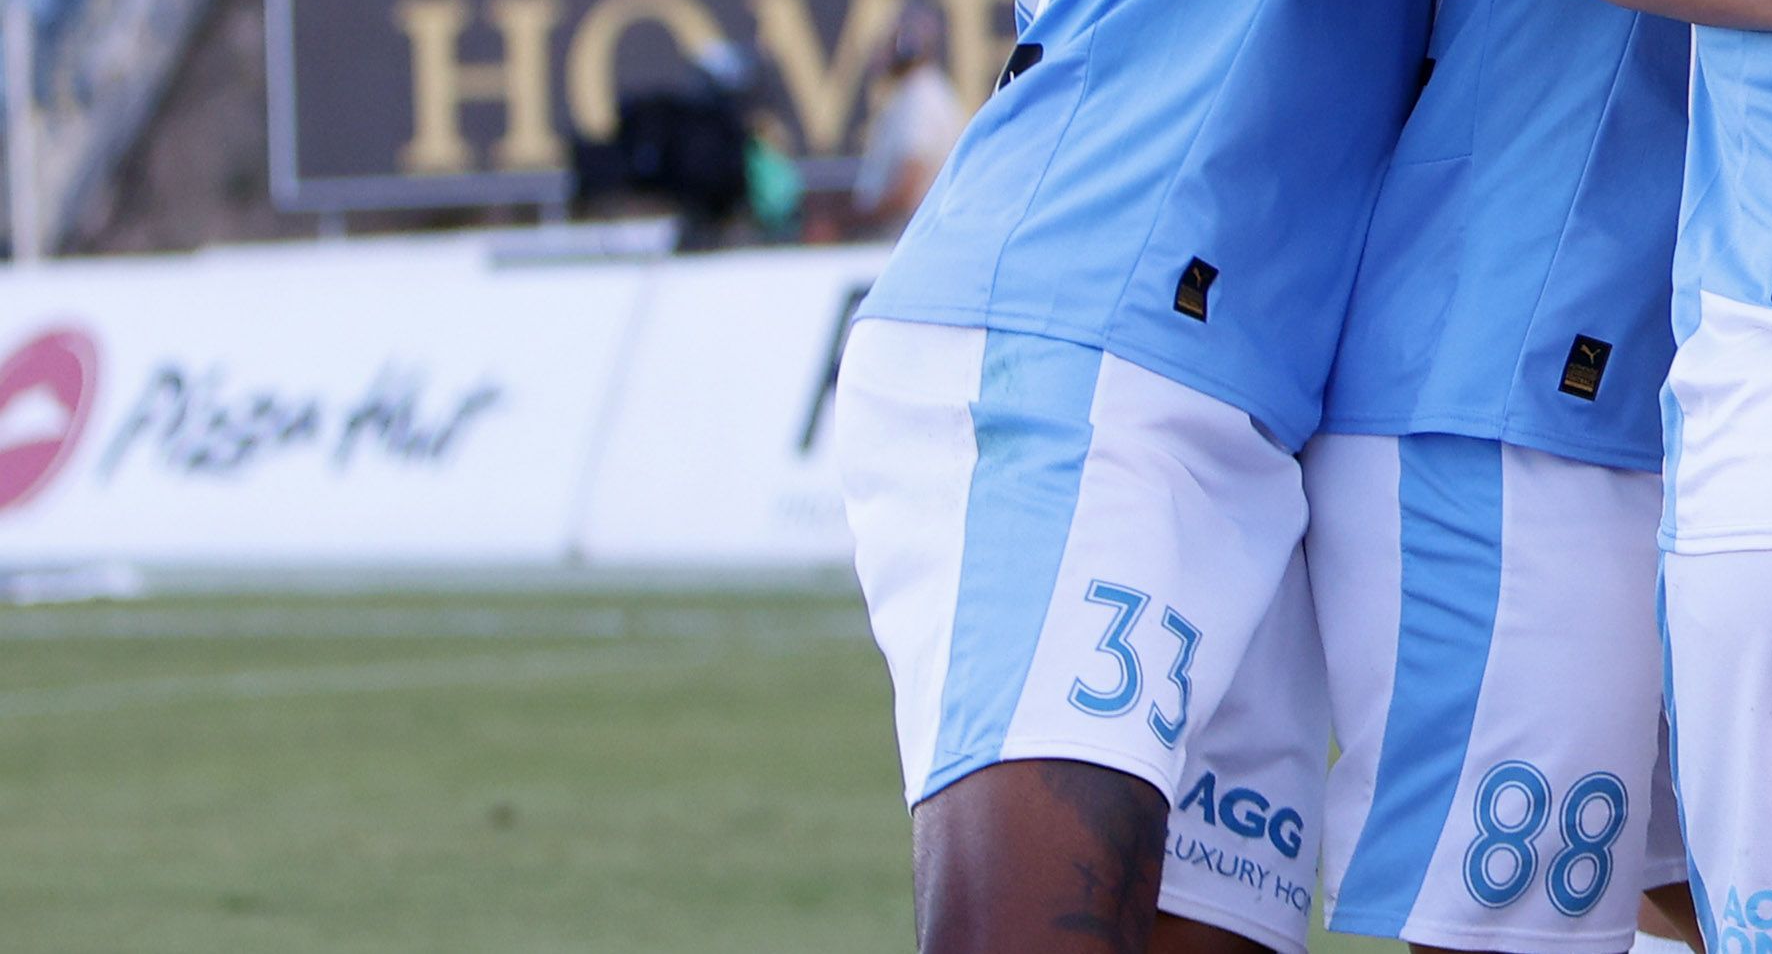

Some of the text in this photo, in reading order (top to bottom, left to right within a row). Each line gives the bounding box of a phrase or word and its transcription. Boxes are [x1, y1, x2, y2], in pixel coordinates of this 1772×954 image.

[1067, 579, 1203, 750] 33
[1178, 770, 1305, 859] AGG
[1463, 760, 1629, 918] 88
